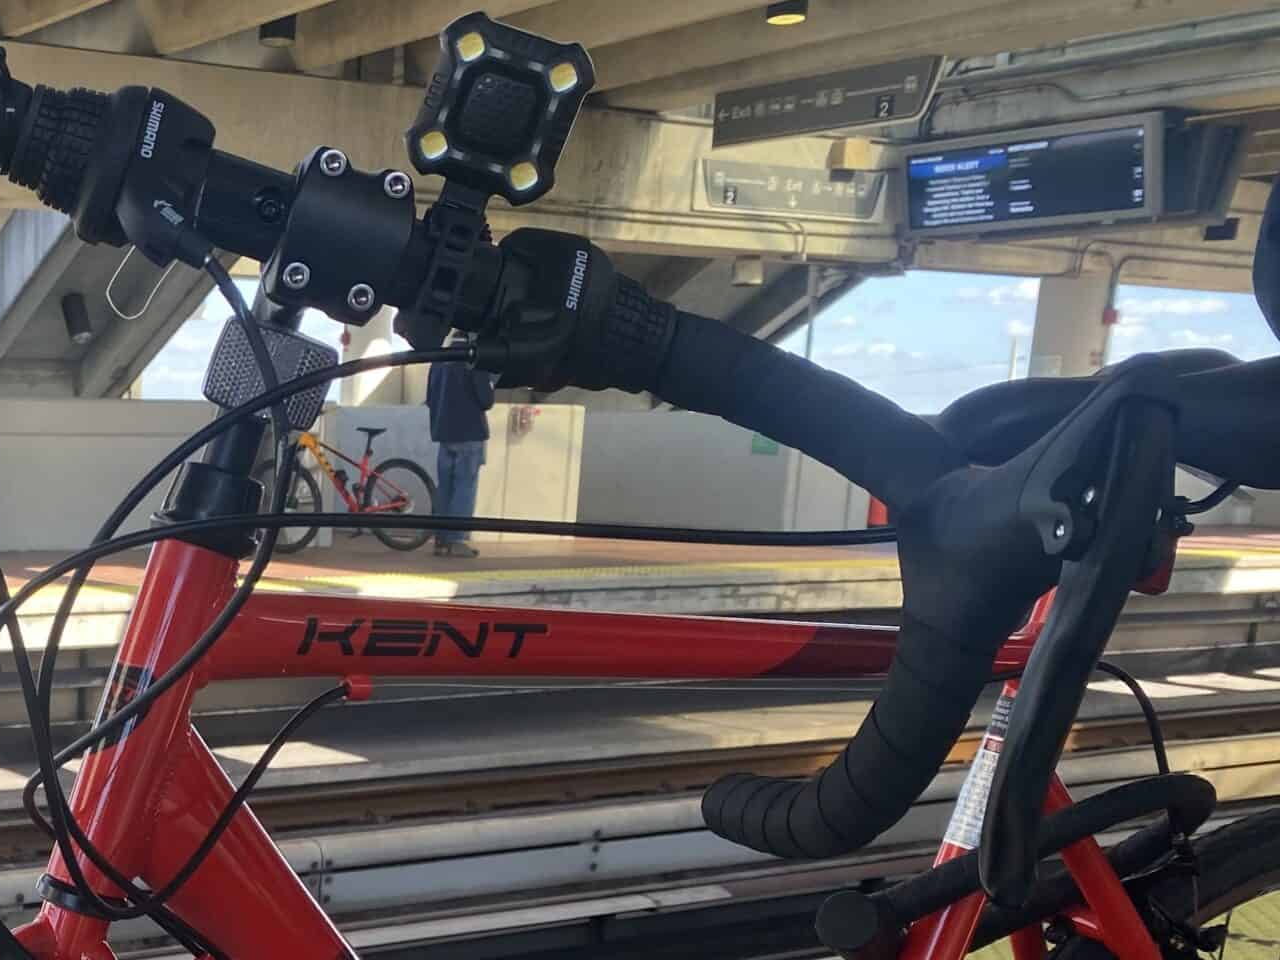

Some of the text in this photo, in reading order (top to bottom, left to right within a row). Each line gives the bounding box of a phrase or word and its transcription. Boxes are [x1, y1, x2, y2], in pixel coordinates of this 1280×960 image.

[140, 100, 165, 159] SHIMANO
[879, 102, 889, 117] 2
[726, 191, 735, 204] 2
[565, 249, 589, 311] SHIMANO
[297, 616, 548, 658] KENT
